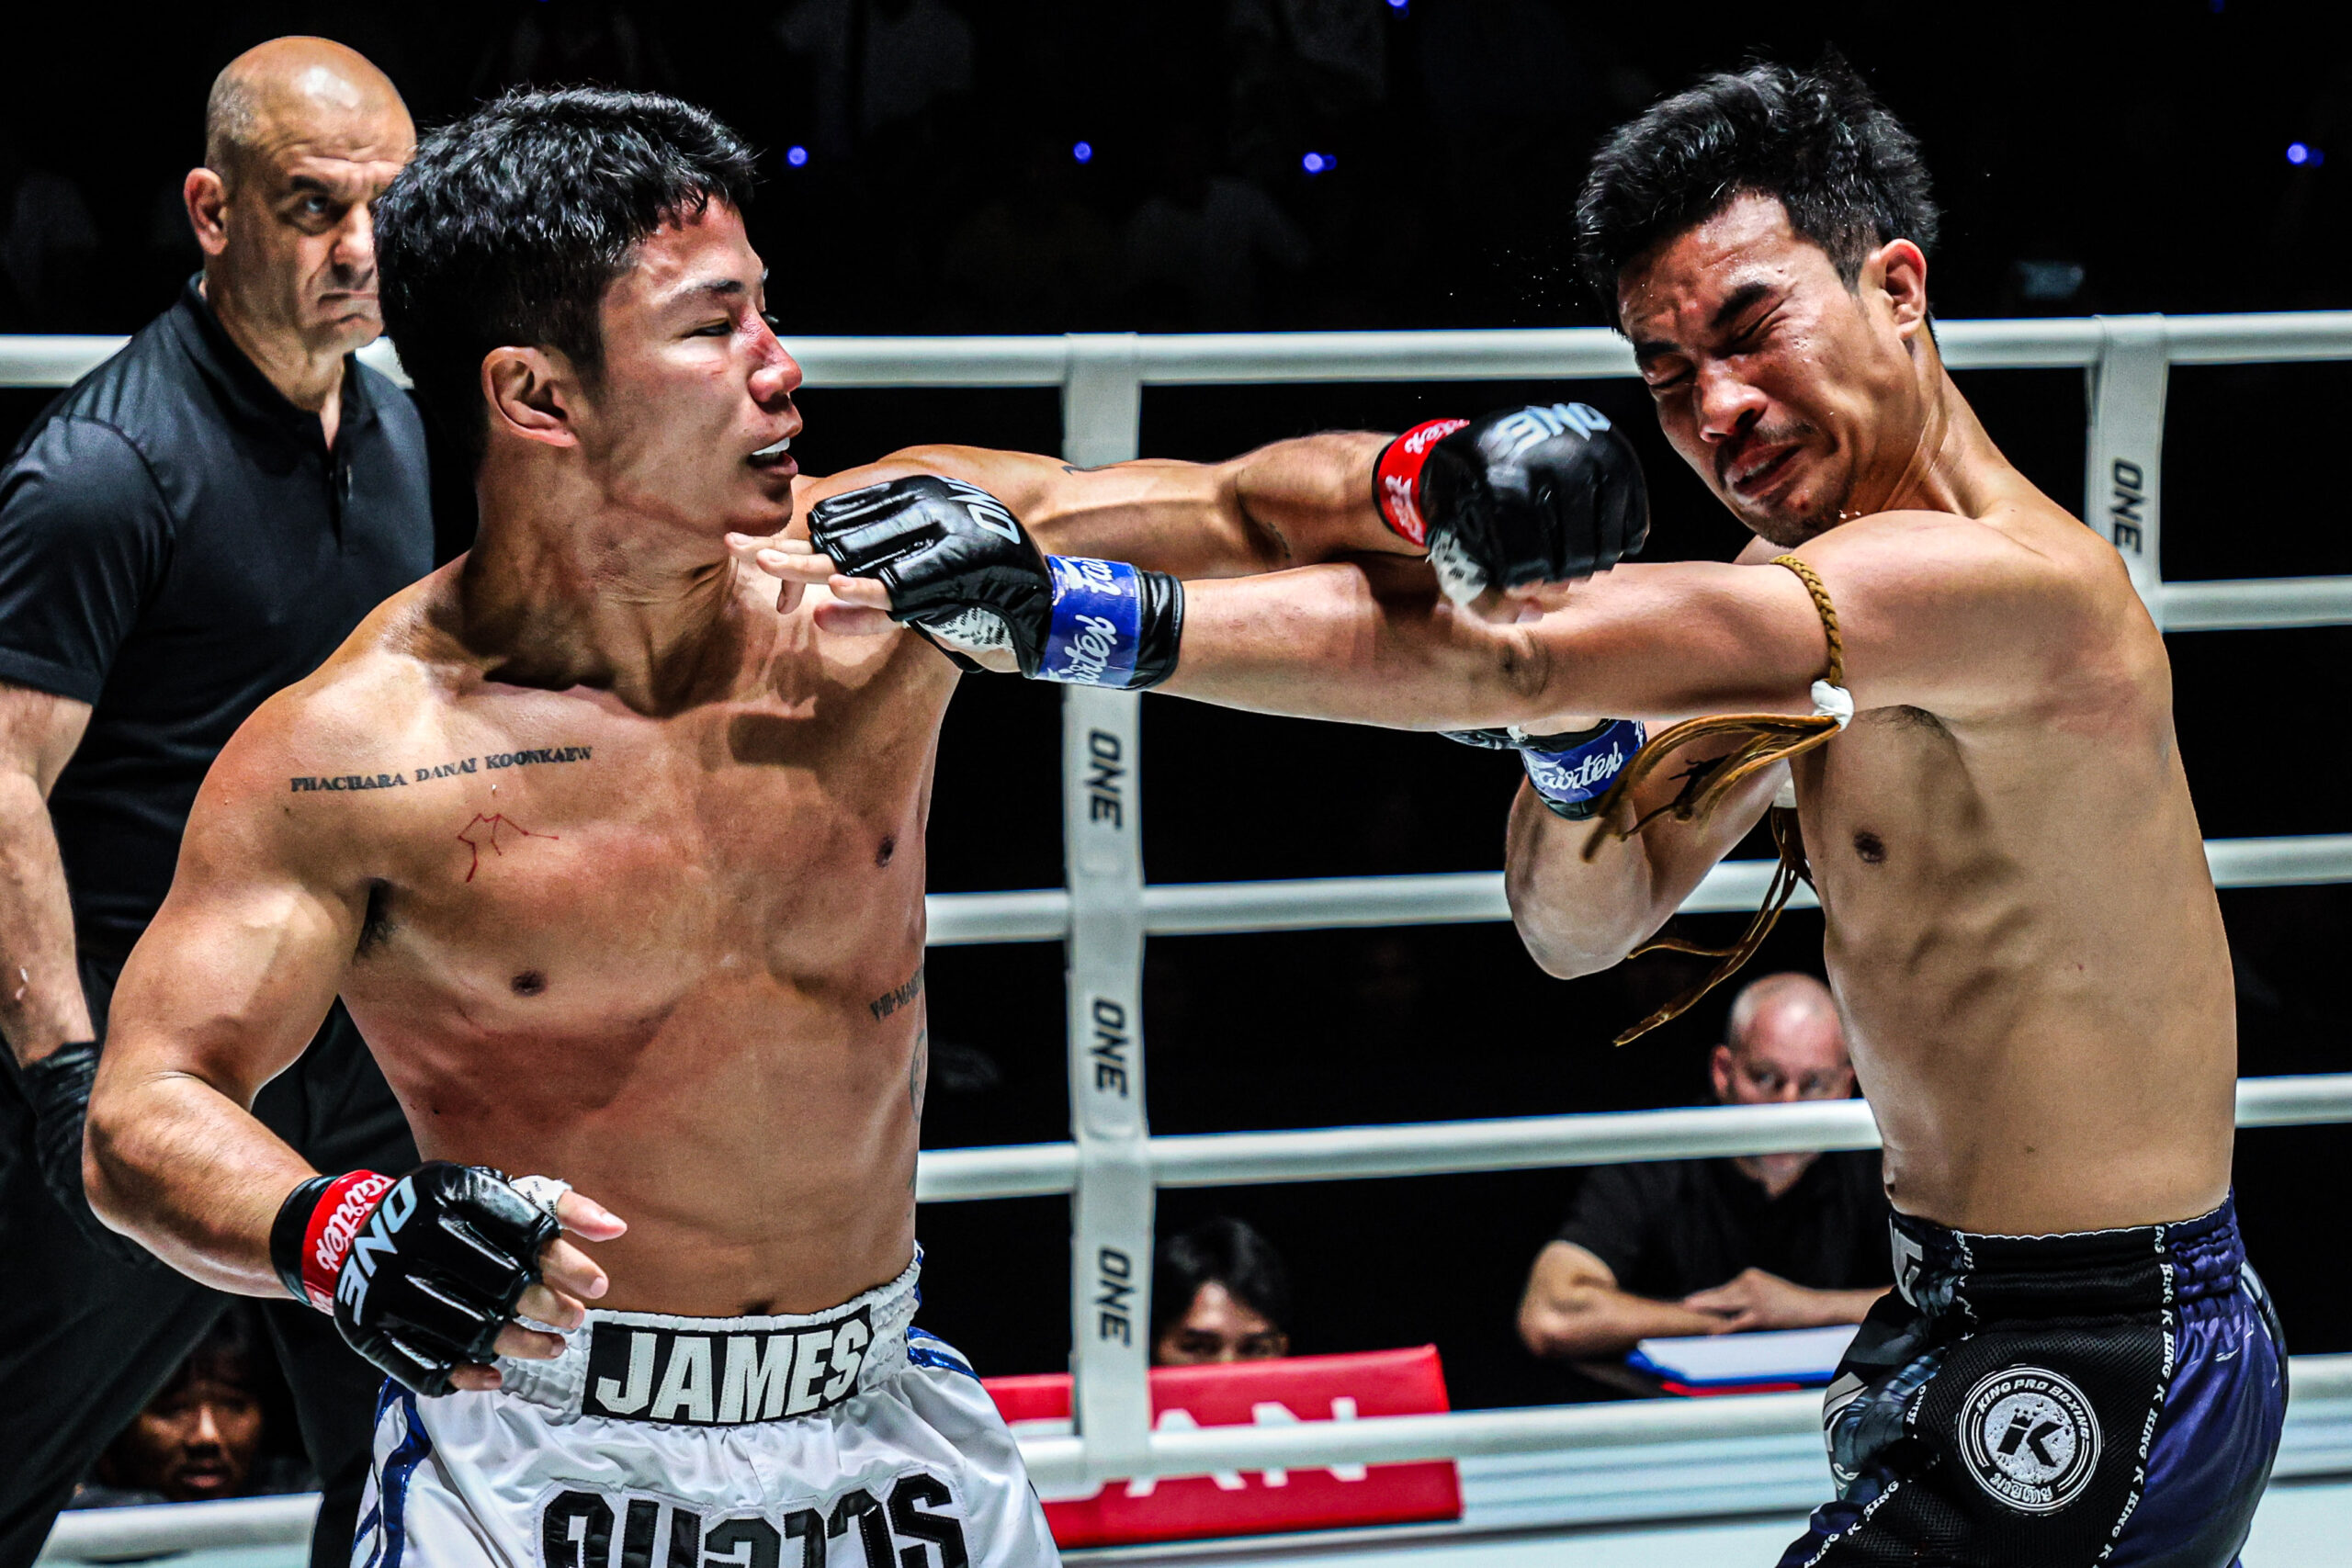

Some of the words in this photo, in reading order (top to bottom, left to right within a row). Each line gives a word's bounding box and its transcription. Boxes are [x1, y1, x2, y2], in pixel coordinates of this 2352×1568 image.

[2111, 458, 2147, 556] ONE
[1048, 614, 1118, 685] irtex
[290, 773, 407, 792] PHACHARA
[415, 758, 477, 782] DANAI
[485, 747, 594, 770] KOONKAEW
[1085, 728, 1125, 830] ONE
[1528, 741, 1623, 790] Fairtex
[1091, 997, 1129, 1100] ONE
[336, 1176, 418, 1325] ONE
[1095, 1247, 1136, 1348] ONE
[595, 1317, 869, 1423] JAMES
[2162, 1331, 2175, 1379] KING
[1976, 1382, 2011, 1414] KING
[2014, 1379, 2049, 1391] PRO
[2048, 1385, 2091, 1439] BOXING
[2154, 1384, 2165, 1402] K
[2139, 1407, 2158, 1460] KING
[2132, 1465, 2144, 1484] K
[2111, 1490, 2140, 1538] KING
[2098, 1543, 2113, 1560] K
